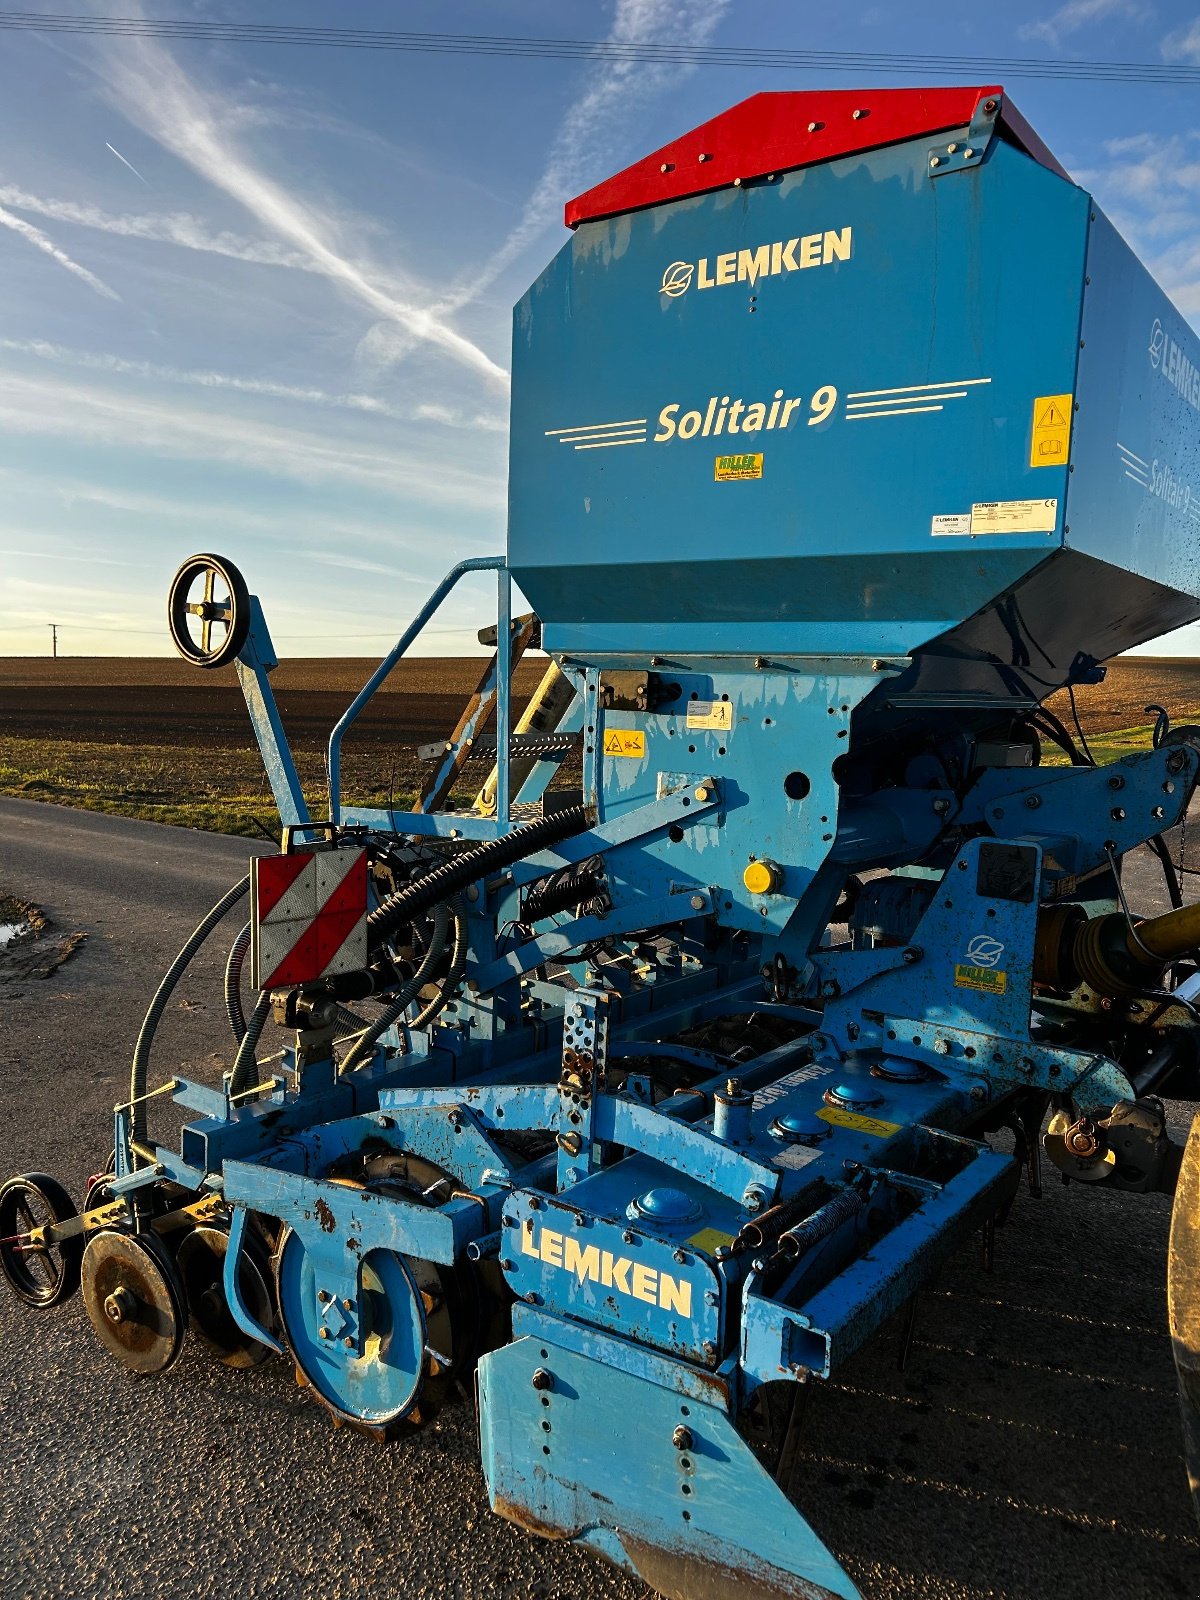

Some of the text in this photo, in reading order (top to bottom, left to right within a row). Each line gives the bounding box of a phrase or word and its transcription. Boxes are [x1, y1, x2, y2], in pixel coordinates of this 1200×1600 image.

[697, 226, 852, 289] LEMKEN
[1161, 333, 1200, 411] LEMKE
[654, 385, 838, 442] Solitair 9
[522, 1220, 692, 1319] LEMKEN
